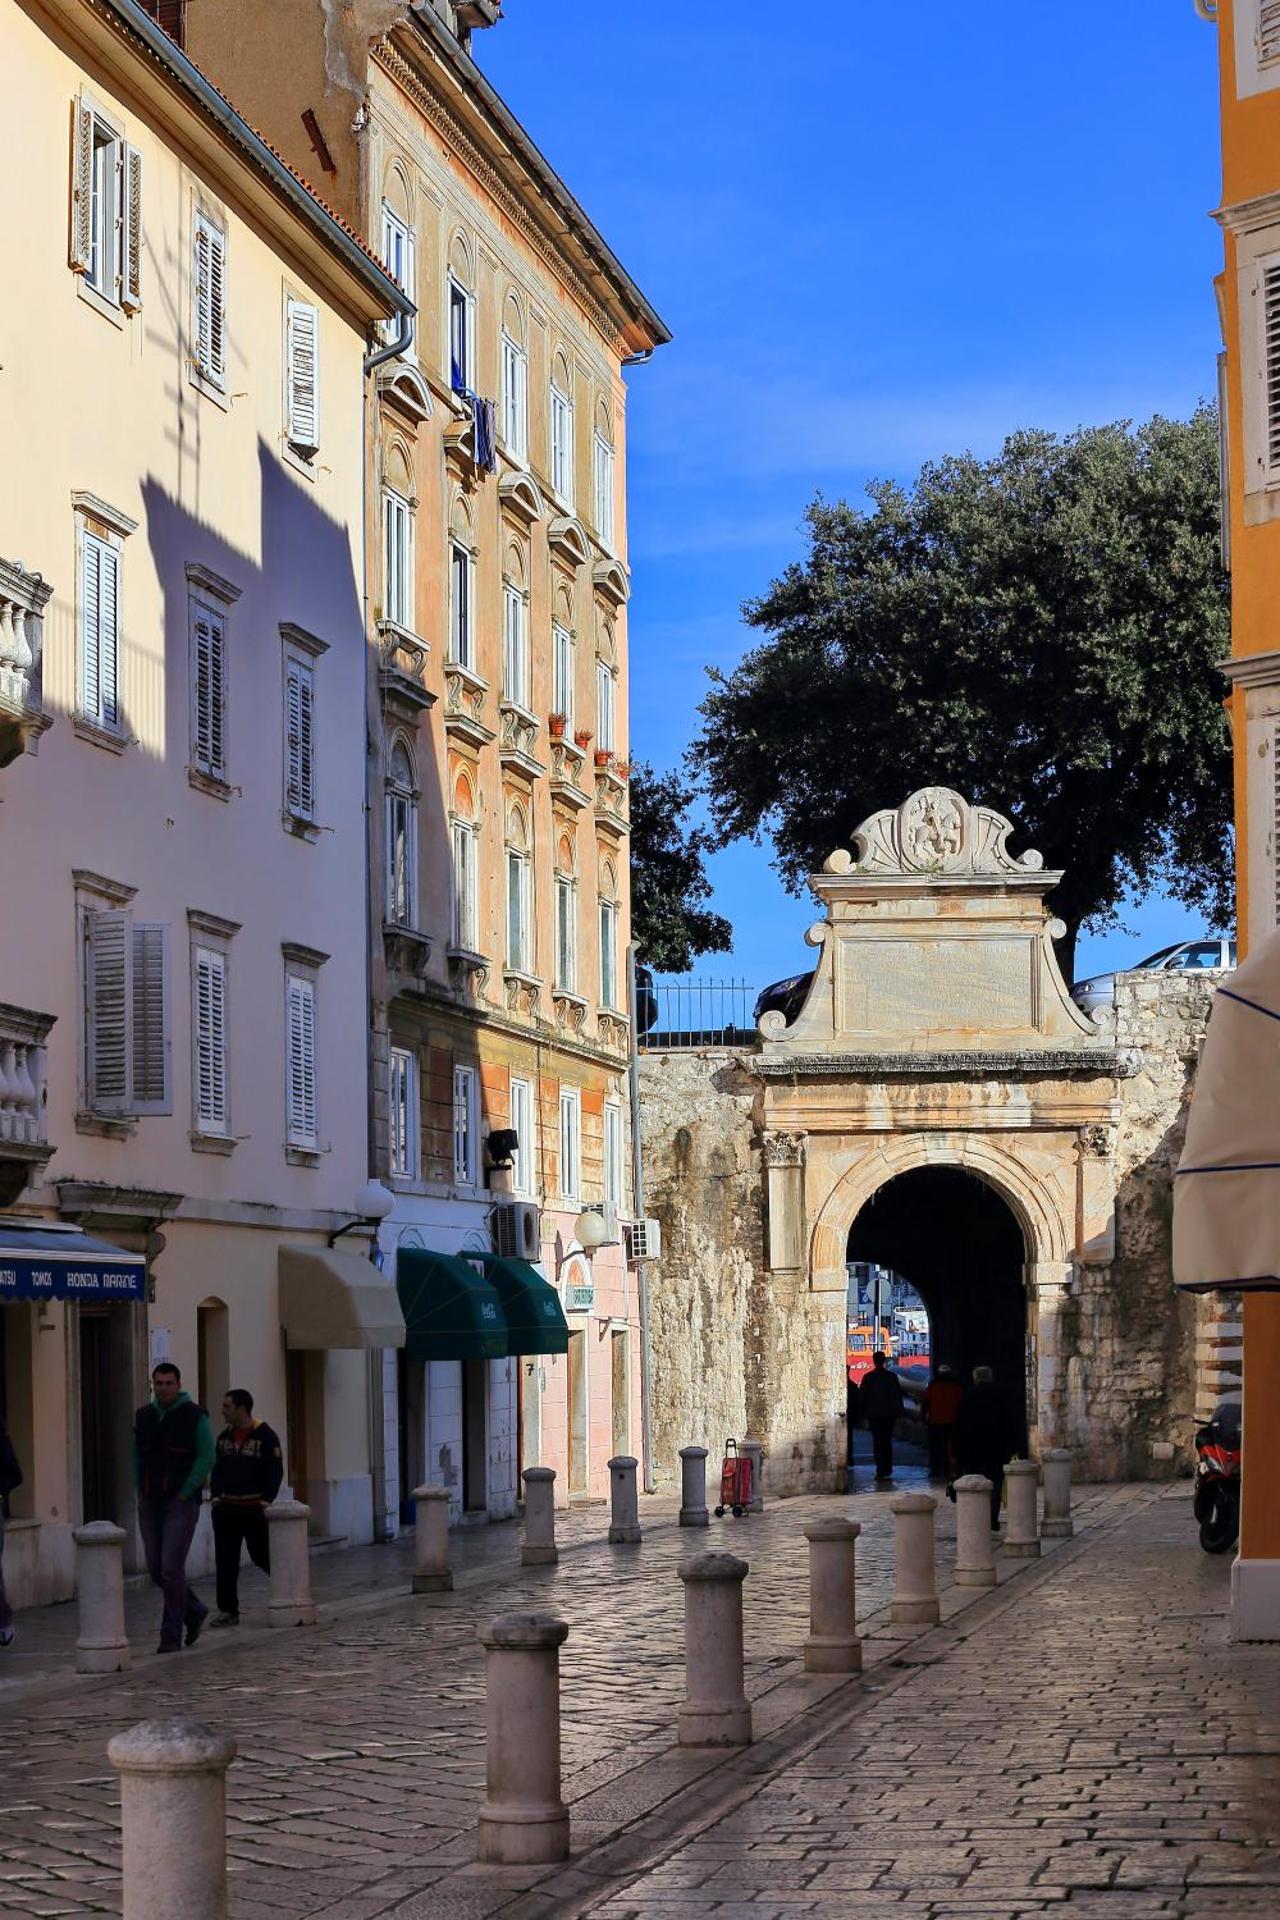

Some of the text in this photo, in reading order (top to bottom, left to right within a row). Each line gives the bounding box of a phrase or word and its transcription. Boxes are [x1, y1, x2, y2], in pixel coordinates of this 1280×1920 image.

[31, 1271, 52, 1286] TOMOS
[67, 1272, 99, 1288] HONDA
[526, 1363, 535, 1377] 7
